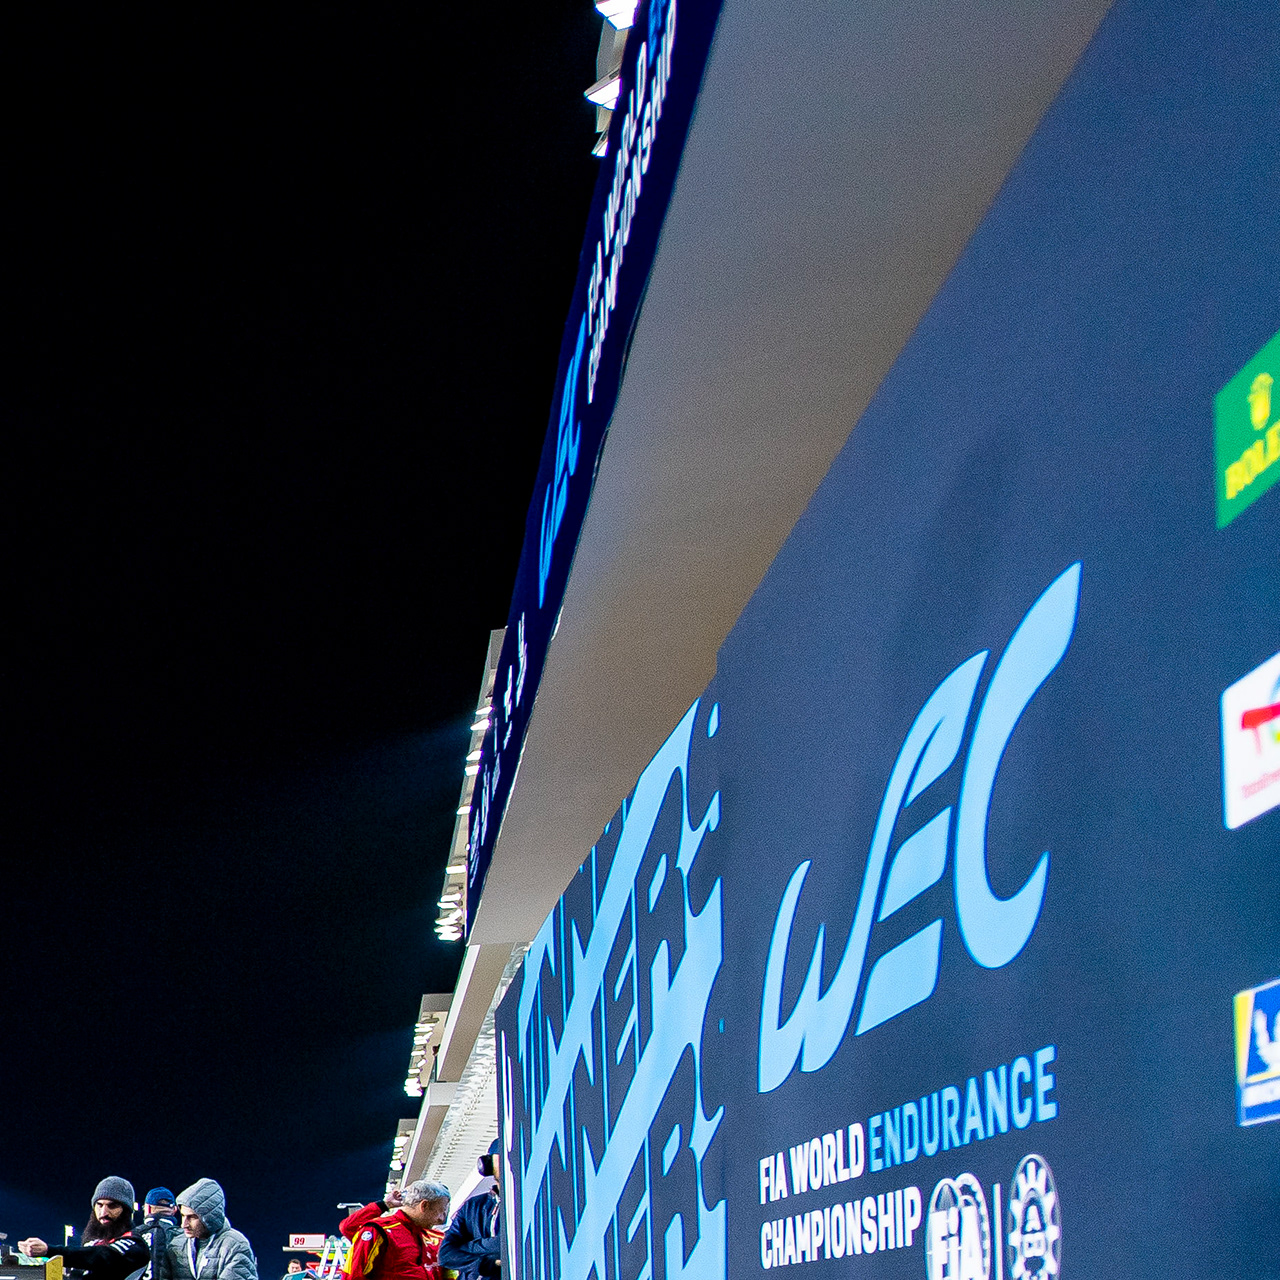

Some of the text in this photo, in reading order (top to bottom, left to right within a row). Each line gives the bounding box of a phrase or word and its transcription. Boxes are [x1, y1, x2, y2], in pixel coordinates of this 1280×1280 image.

[758, 562, 1083, 1093] WEC
[760, 1045, 1058, 1204] FIA WORLD ENDURANCE
[761, 1186, 922, 1269] CHAMPIONSHIP
